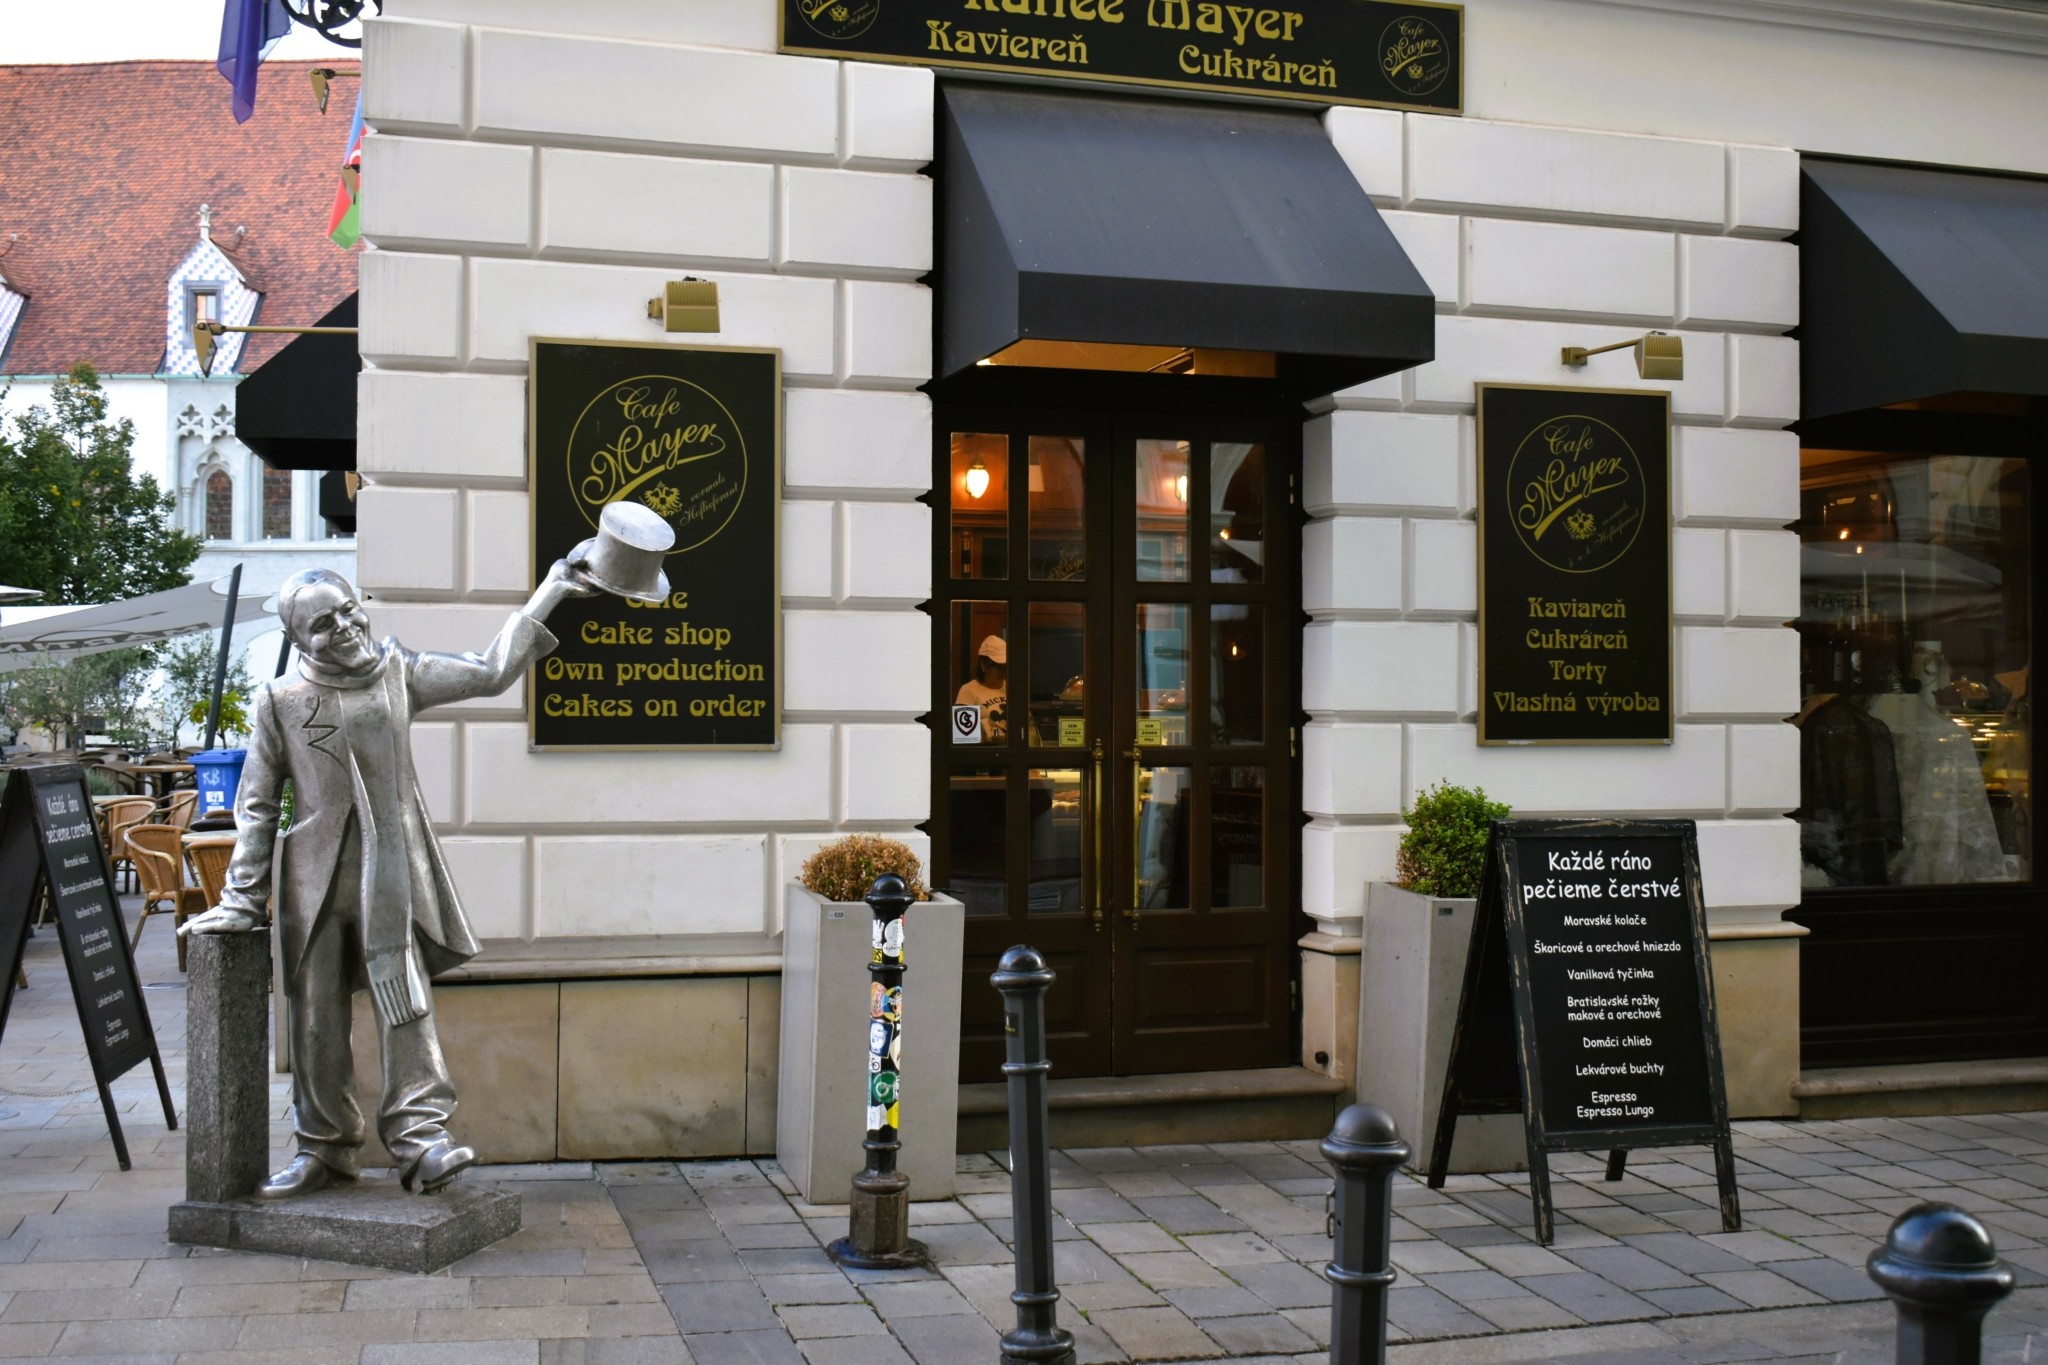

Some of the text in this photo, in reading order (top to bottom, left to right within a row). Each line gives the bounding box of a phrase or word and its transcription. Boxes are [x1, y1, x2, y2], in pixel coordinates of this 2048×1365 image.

[1147, 0, 1303, 46] Mayer
[926, 19, 1089, 65] Kaviereň
[1179, 44, 1338, 89] Cukráreň
[615, 386, 681, 429] Cafe
[1543, 425, 1595, 462] Cafe
[581, 424, 718, 505] Mayer
[1519, 457, 1622, 530] Mayer
[1527, 596, 1627, 619] Kaviareň
[581, 620, 731, 650] Cake shop
[1526, 628, 1629, 650] Cukráreň
[545, 656, 765, 686] Own production
[1548, 659, 1607, 686] Torty
[543, 693, 766, 717] Cakes on order
[1493, 691, 1661, 716] Vlastná výroba
[1548, 849, 1652, 871] Každé ráno
[1523, 877, 1682, 904] pečieme čerstvé
[1563, 914, 1612, 926] Moravské
[1534, 939, 1682, 954] Škoricové a orechové hniezdo
[1567, 967, 1655, 982] Vanilková tyčinka
[1567, 994, 1660, 1009] Bratislavské rožky
[1567, 1007, 1662, 1021] makové a orechové
[1582, 1035, 1653, 1048] Domáci chlieb
[1575, 1062, 1665, 1076] Lekvárové buchty
[1591, 1091, 1637, 1105] Espresso
[1576, 1104, 1655, 1120] Espresso Lungo
